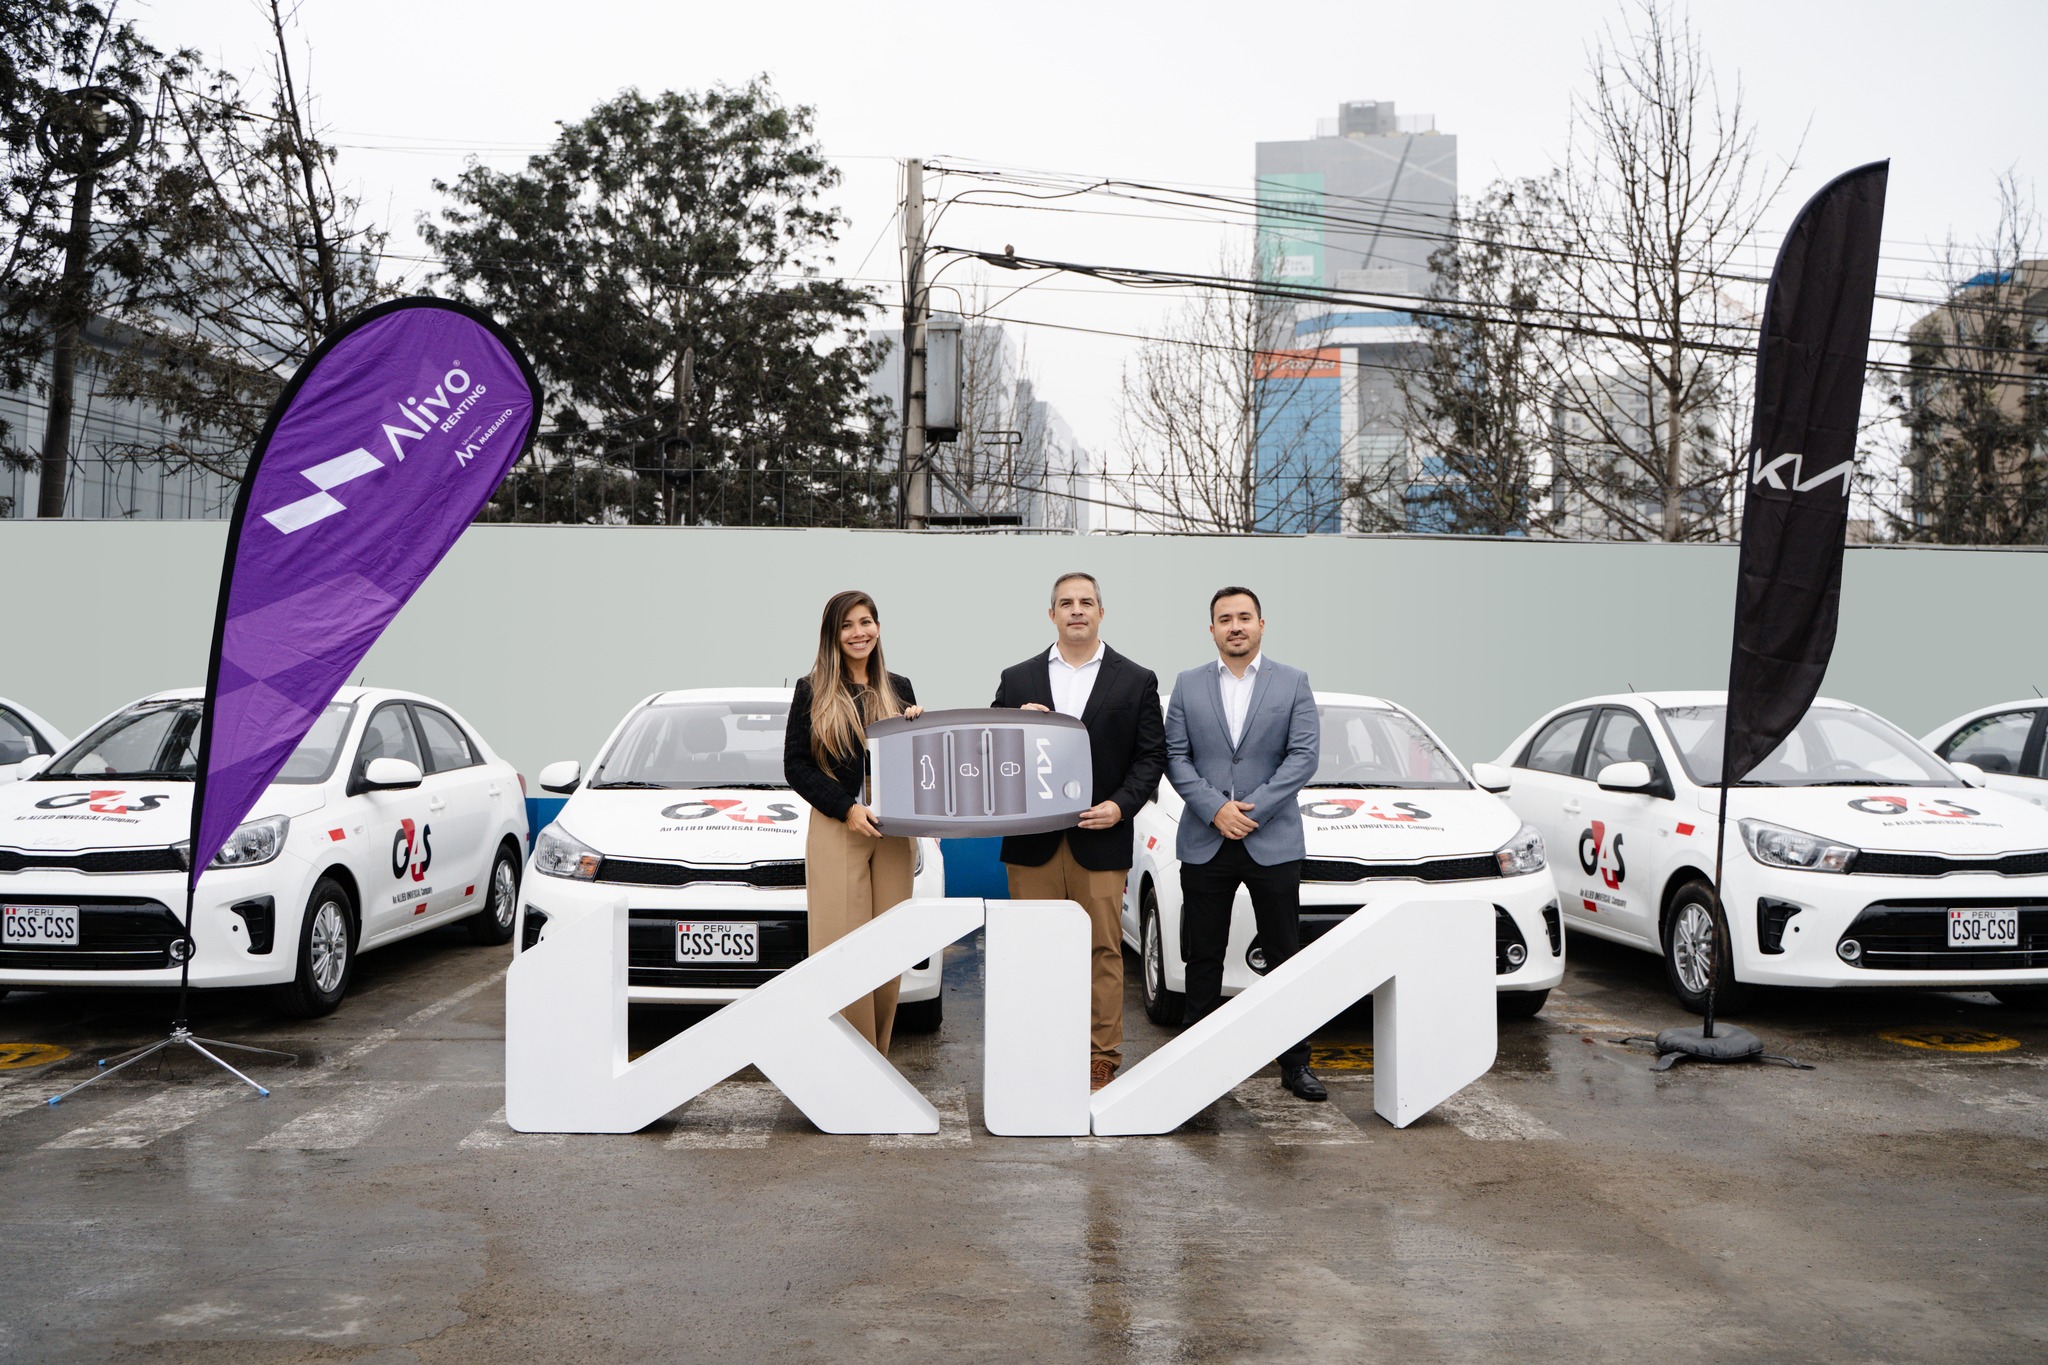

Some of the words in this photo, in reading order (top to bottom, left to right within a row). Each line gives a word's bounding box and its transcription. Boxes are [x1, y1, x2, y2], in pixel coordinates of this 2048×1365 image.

[382, 369, 470, 462] Alivo
[440, 384, 486, 433] RENTING
[479, 409, 512, 444] MAREAUTO
[1752, 447, 1854, 498] KIA
[1036, 738, 1053, 799] KIA
[35, 790, 170, 814] G4S
[661, 799, 799, 824] G4S
[1299, 798, 1432, 822] G4S
[1847, 795, 1981, 819] G4S
[102, 815, 142, 824] Company
[757, 826, 798, 834] Company
[1407, 824, 1445, 832] Company
[392, 818, 432, 882] G4S
[1579, 820, 1625, 890] G4S
[28, 908, 54, 916] PERU
[1972, 911, 1997, 919] PERU
[6, 916, 74, 938] CSS-CSS
[703, 925, 732, 933] PERU
[1952, 919, 2016, 940] CSQ-CSQ
[680, 933, 754, 956] CSS-CSS
[506, 897, 1497, 1137] KIA
